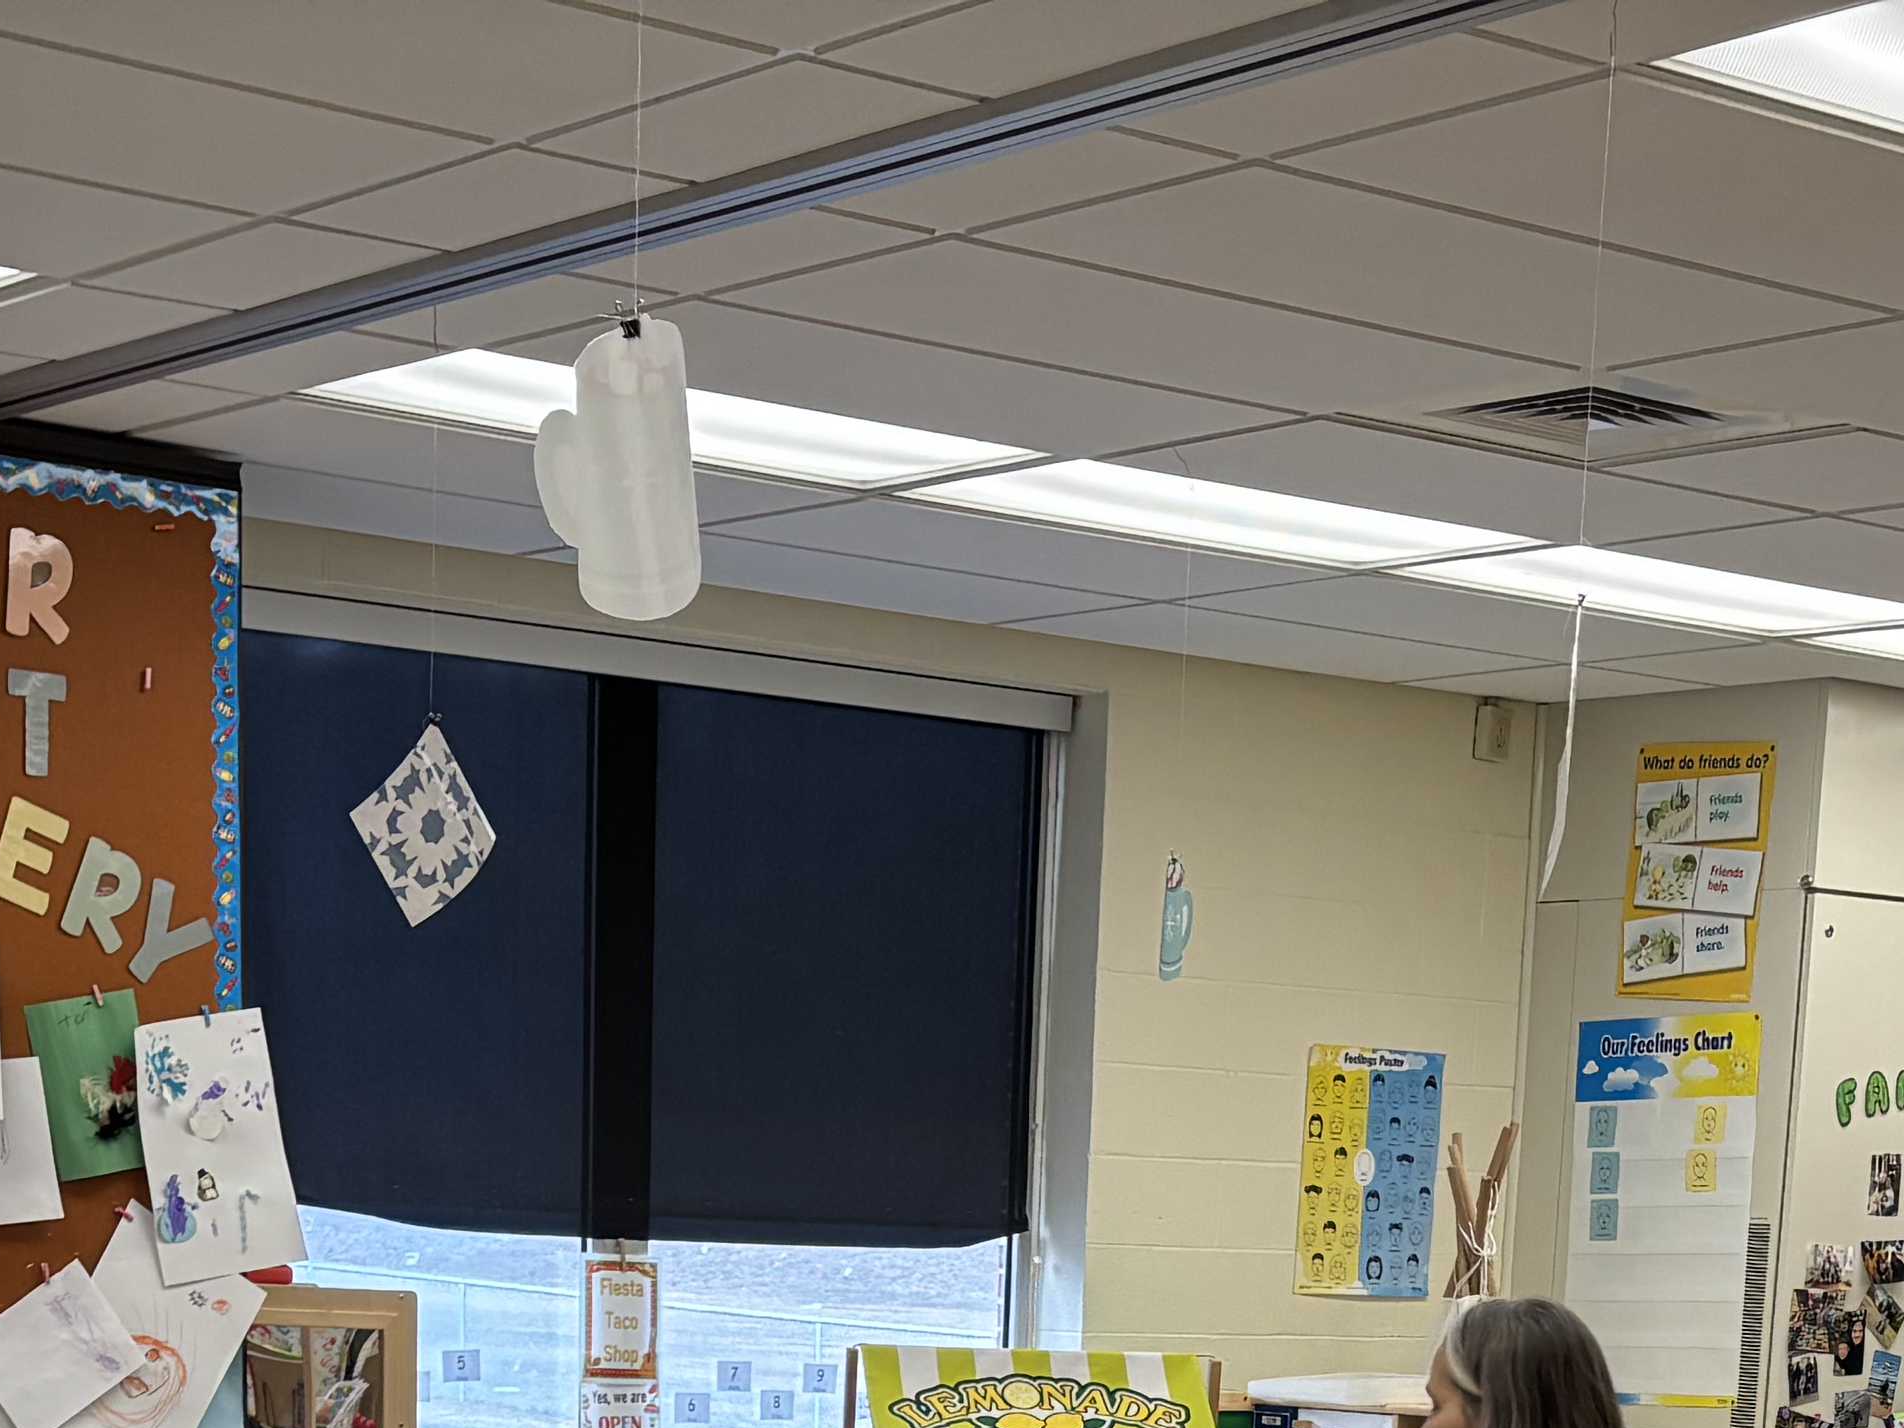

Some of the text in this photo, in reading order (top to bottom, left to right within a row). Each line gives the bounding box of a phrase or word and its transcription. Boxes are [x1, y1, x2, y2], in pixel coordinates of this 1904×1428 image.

[1642, 753, 1769, 771] What do friends do?
[1709, 793, 1743, 806] Friends
[1710, 865, 1744, 878] Friends
[1695, 923, 1729, 938] Friends
[1601, 1030, 1733, 1057] Our Feelings Chart
[1344, 1052, 1377, 1067] Feelings
[600, 1278, 643, 1297] Fiesta
[604, 1312, 638, 1330] Taco
[456, 1355, 466, 1370] 5
[603, 1344, 638, 1367] Shop
[730, 1366, 739, 1382] 7
[816, 1369, 825, 1383] 9
[592, 1391, 647, 1405] Yes, we are
[688, 1400, 695, 1411] 6
[773, 1395, 781, 1409] 8
